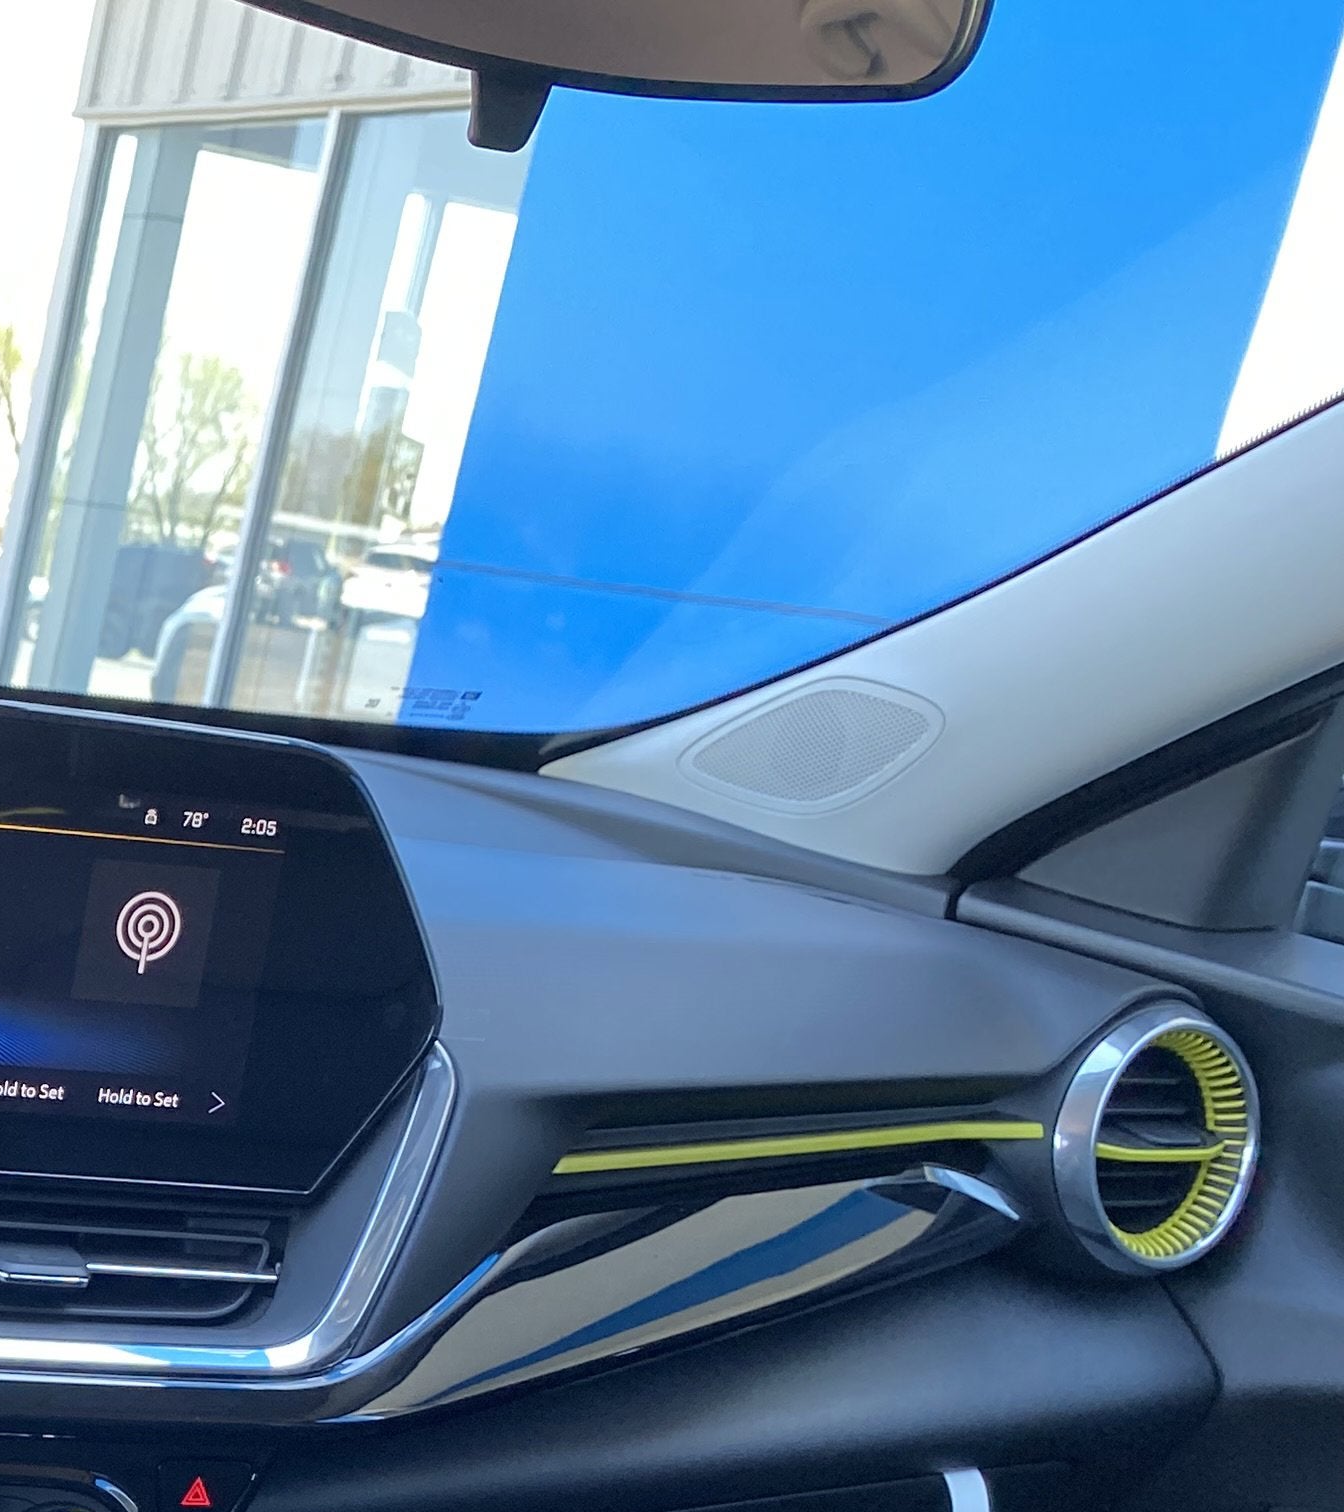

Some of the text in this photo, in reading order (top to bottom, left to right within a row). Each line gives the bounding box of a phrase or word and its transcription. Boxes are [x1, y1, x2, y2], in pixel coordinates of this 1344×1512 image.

[183, 811, 278, 836] 78° 2:05
[19, 1083, 36, 1099] to
[37, 1083, 65, 1101] Set
[97, 1087, 179, 1109] Hold to Set
